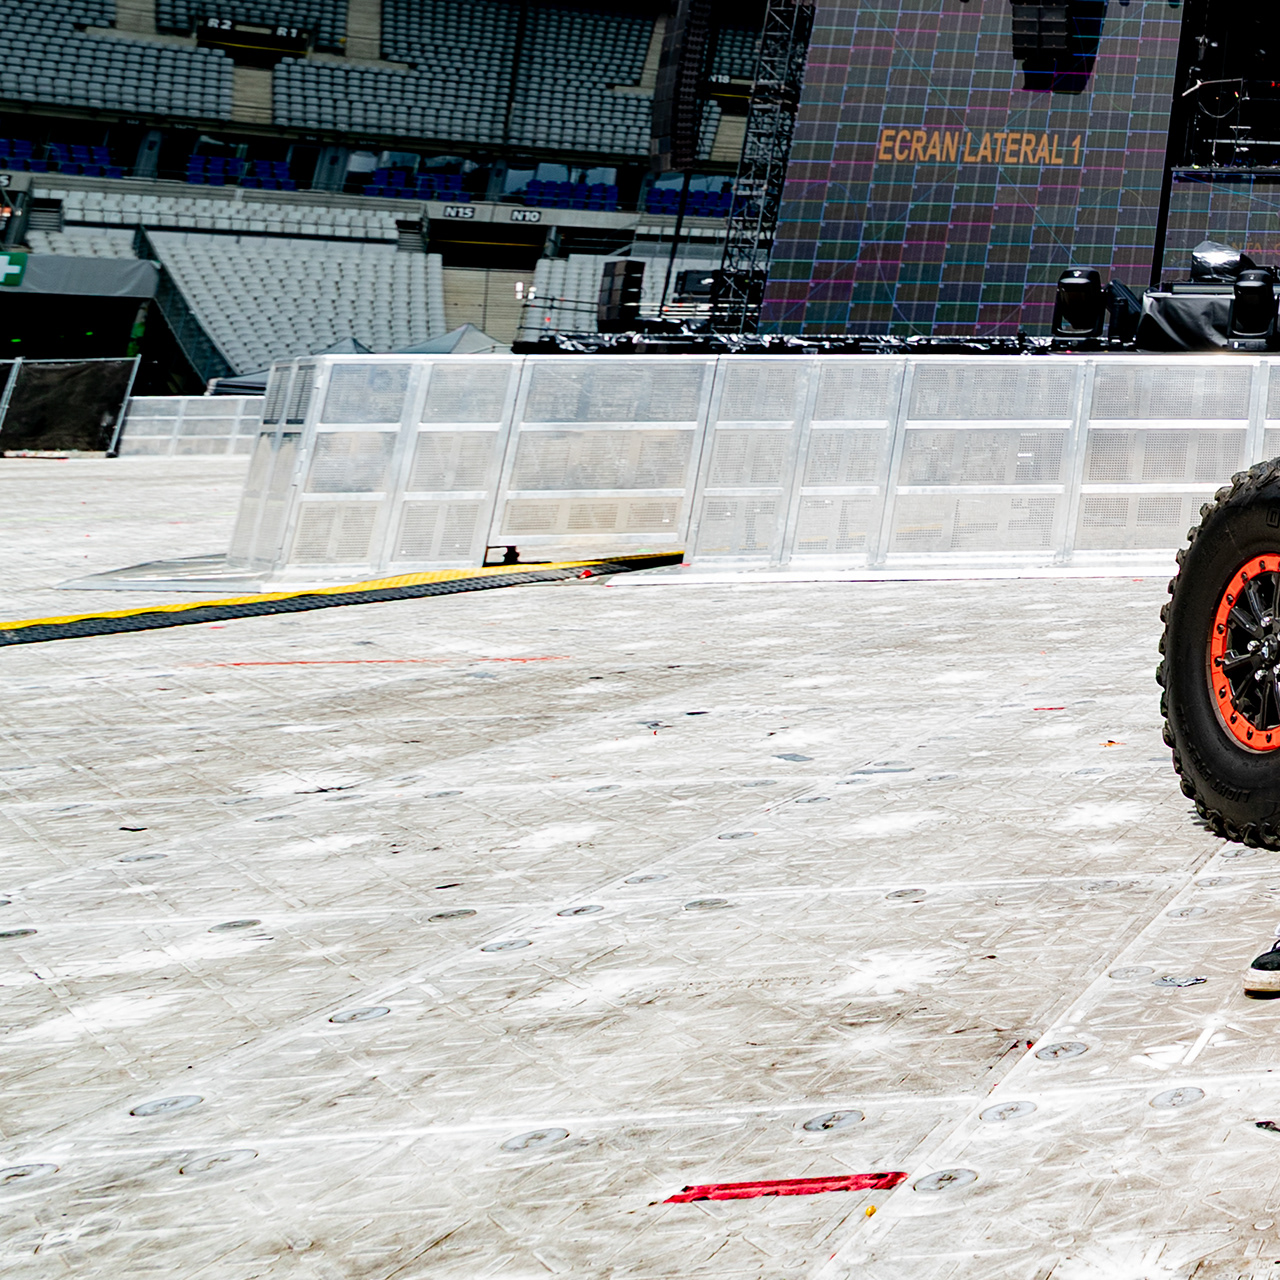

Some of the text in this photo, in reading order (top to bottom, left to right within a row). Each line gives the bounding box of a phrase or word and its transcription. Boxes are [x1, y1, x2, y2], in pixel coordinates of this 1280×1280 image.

[878, 129, 1083, 165] ECRAN LATERAL 1
[445, 206, 474, 218] N15
[512, 209, 541, 222] N10
